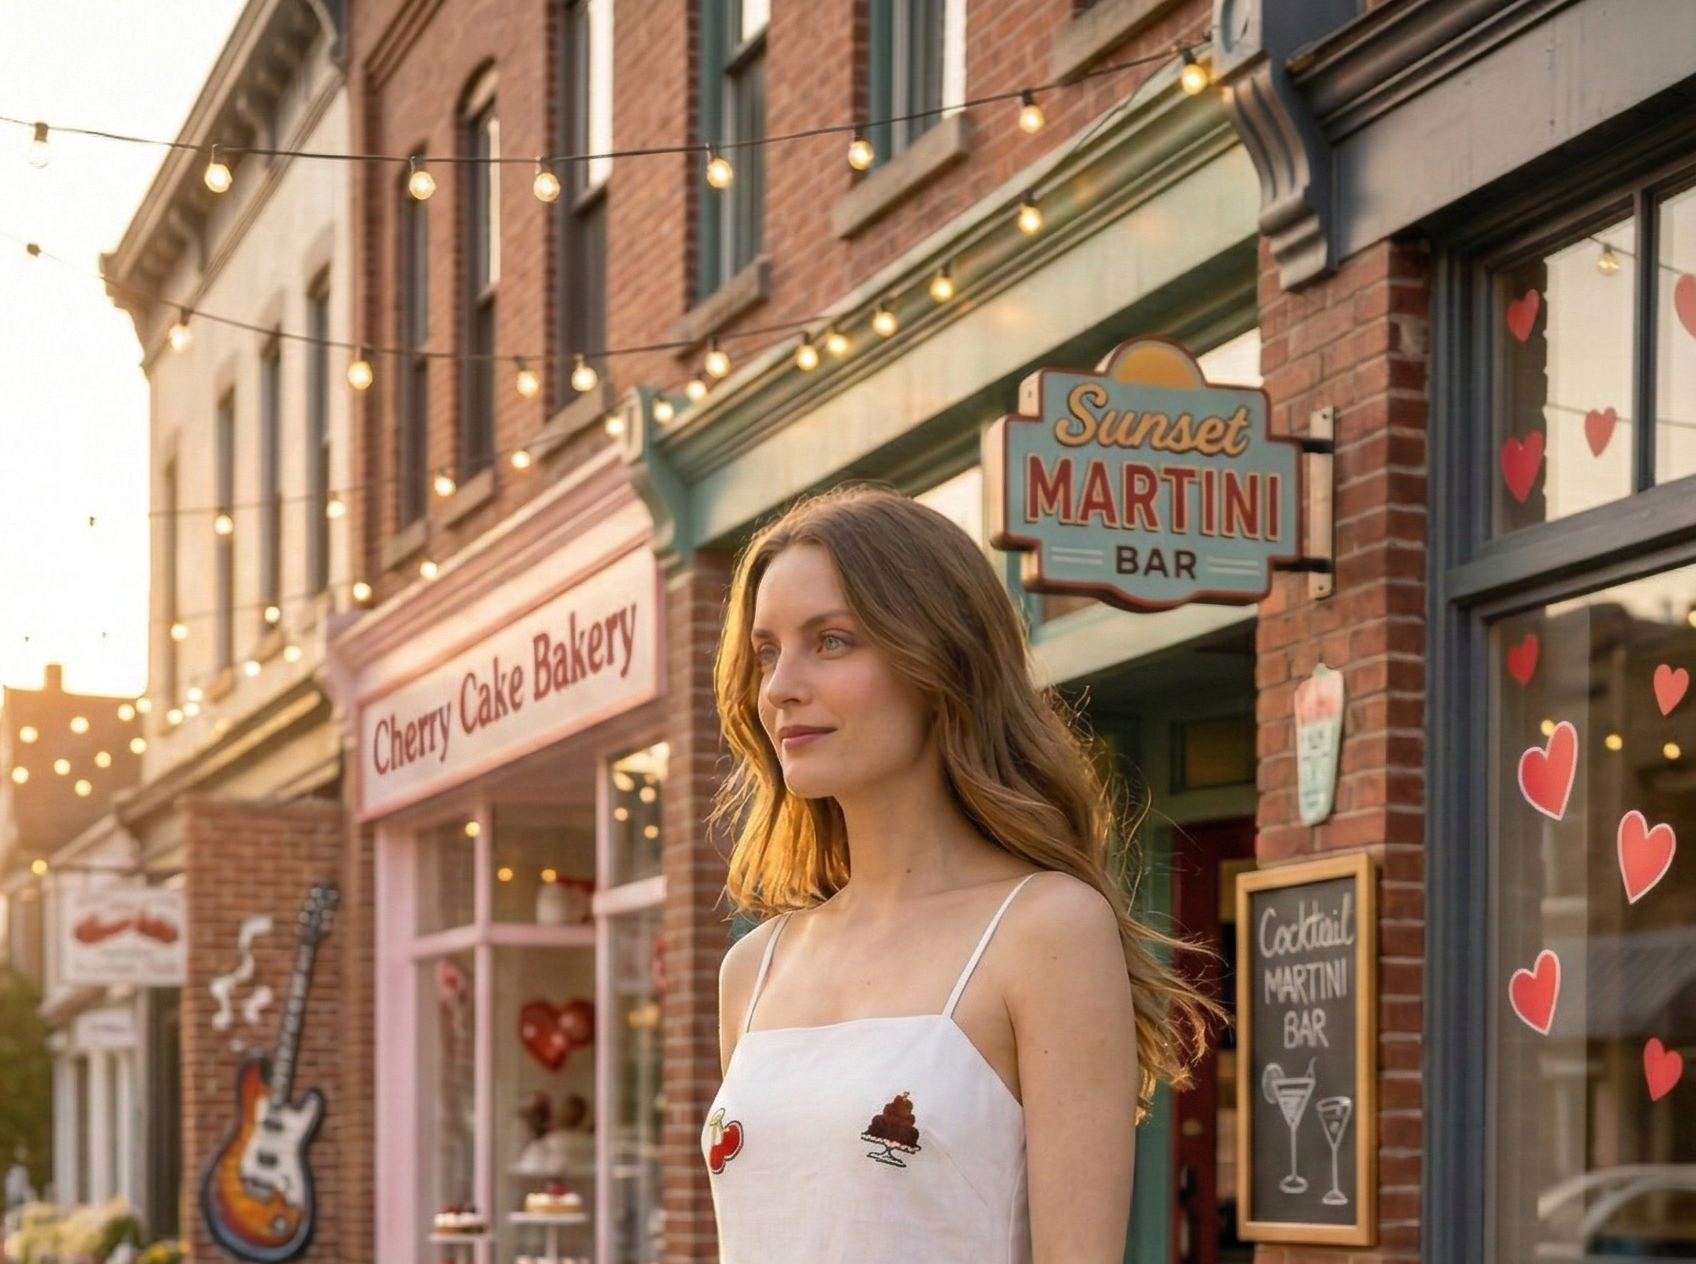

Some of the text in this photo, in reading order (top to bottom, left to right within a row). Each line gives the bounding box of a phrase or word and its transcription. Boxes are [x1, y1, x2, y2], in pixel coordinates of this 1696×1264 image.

[1055, 383, 1249, 457] Sunset
[1024, 453, 1282, 541] MARTINI
[1116, 545, 1197, 579] BAR
[374, 603, 636, 775] Cherry Cake Bakery
[1259, 892, 1354, 958] Cocktail
[1264, 957, 1347, 1005] MARTINI
[1284, 1007, 1329, 1048] BAR
